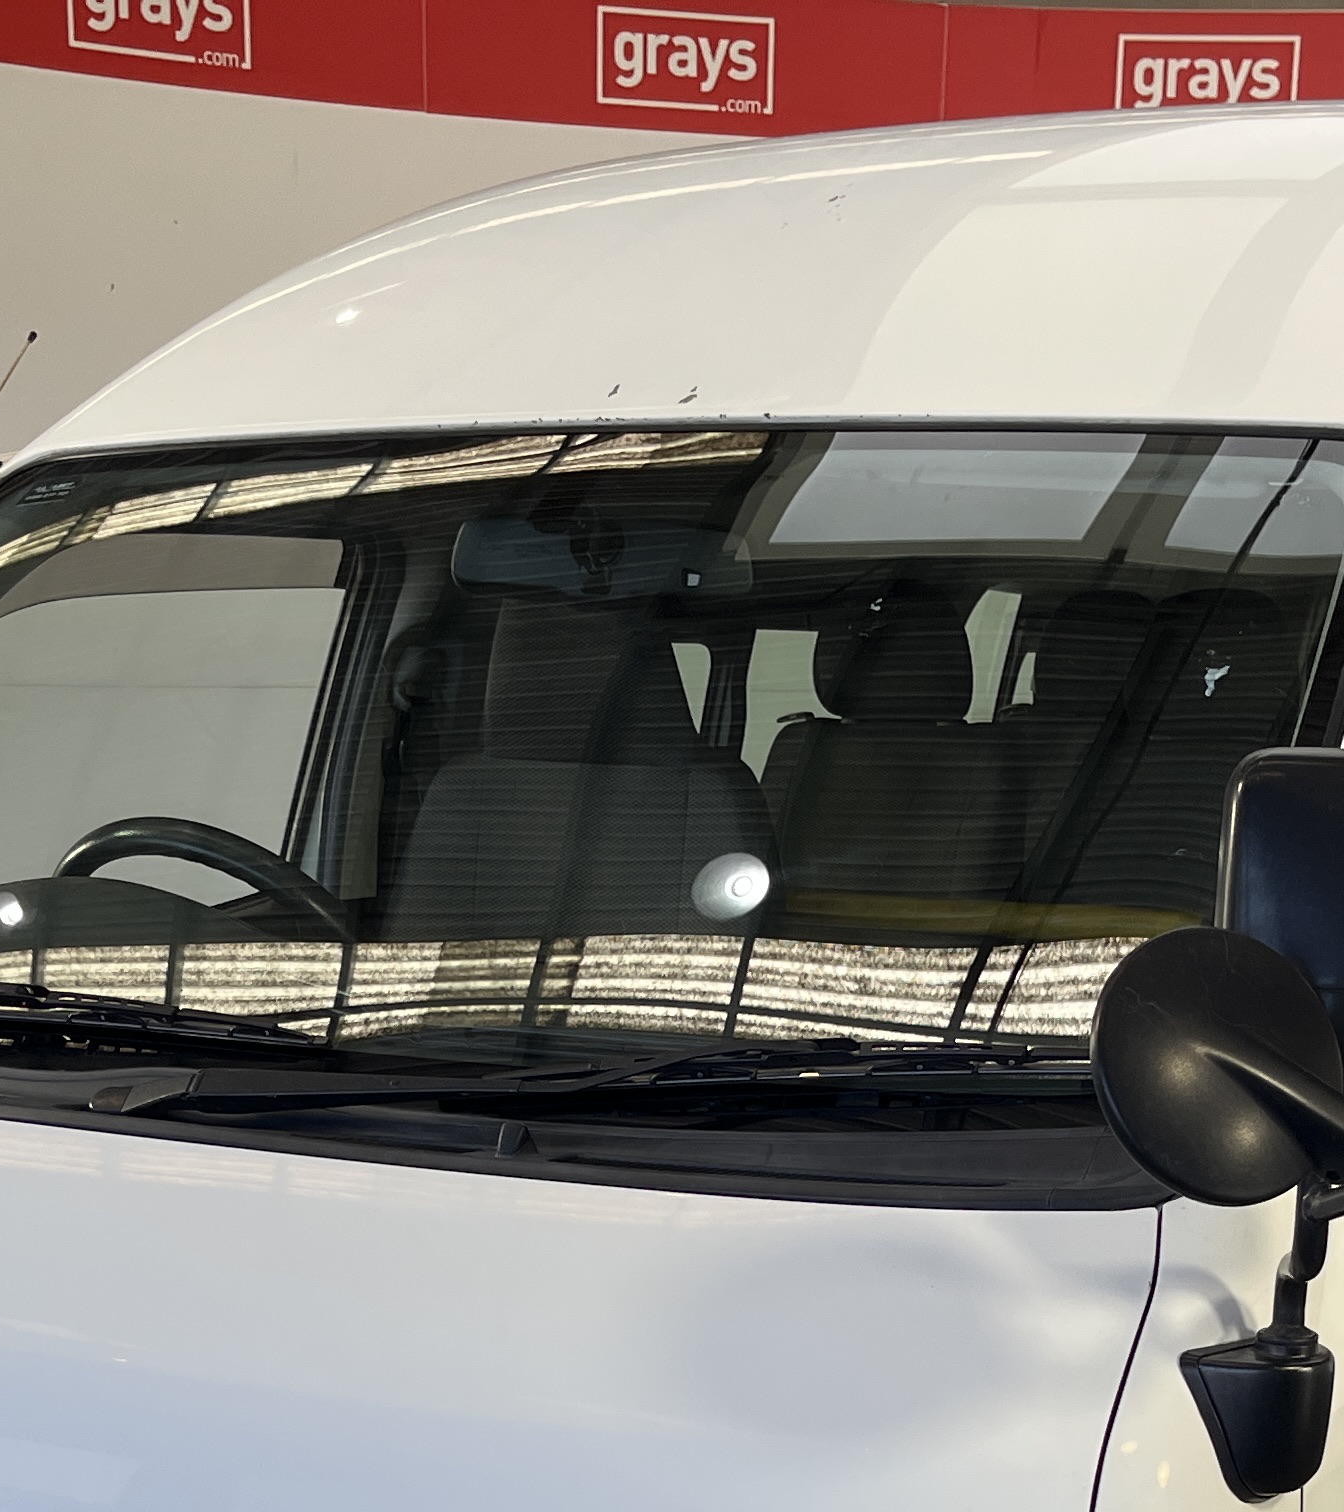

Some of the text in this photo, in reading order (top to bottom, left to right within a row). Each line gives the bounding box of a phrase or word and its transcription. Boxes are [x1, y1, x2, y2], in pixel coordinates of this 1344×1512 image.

[198, 50, 239, 68] .com
[613, 31, 757, 93] grays
[1133, 57, 1281, 108] grays
[720, 98, 762, 114] .com
